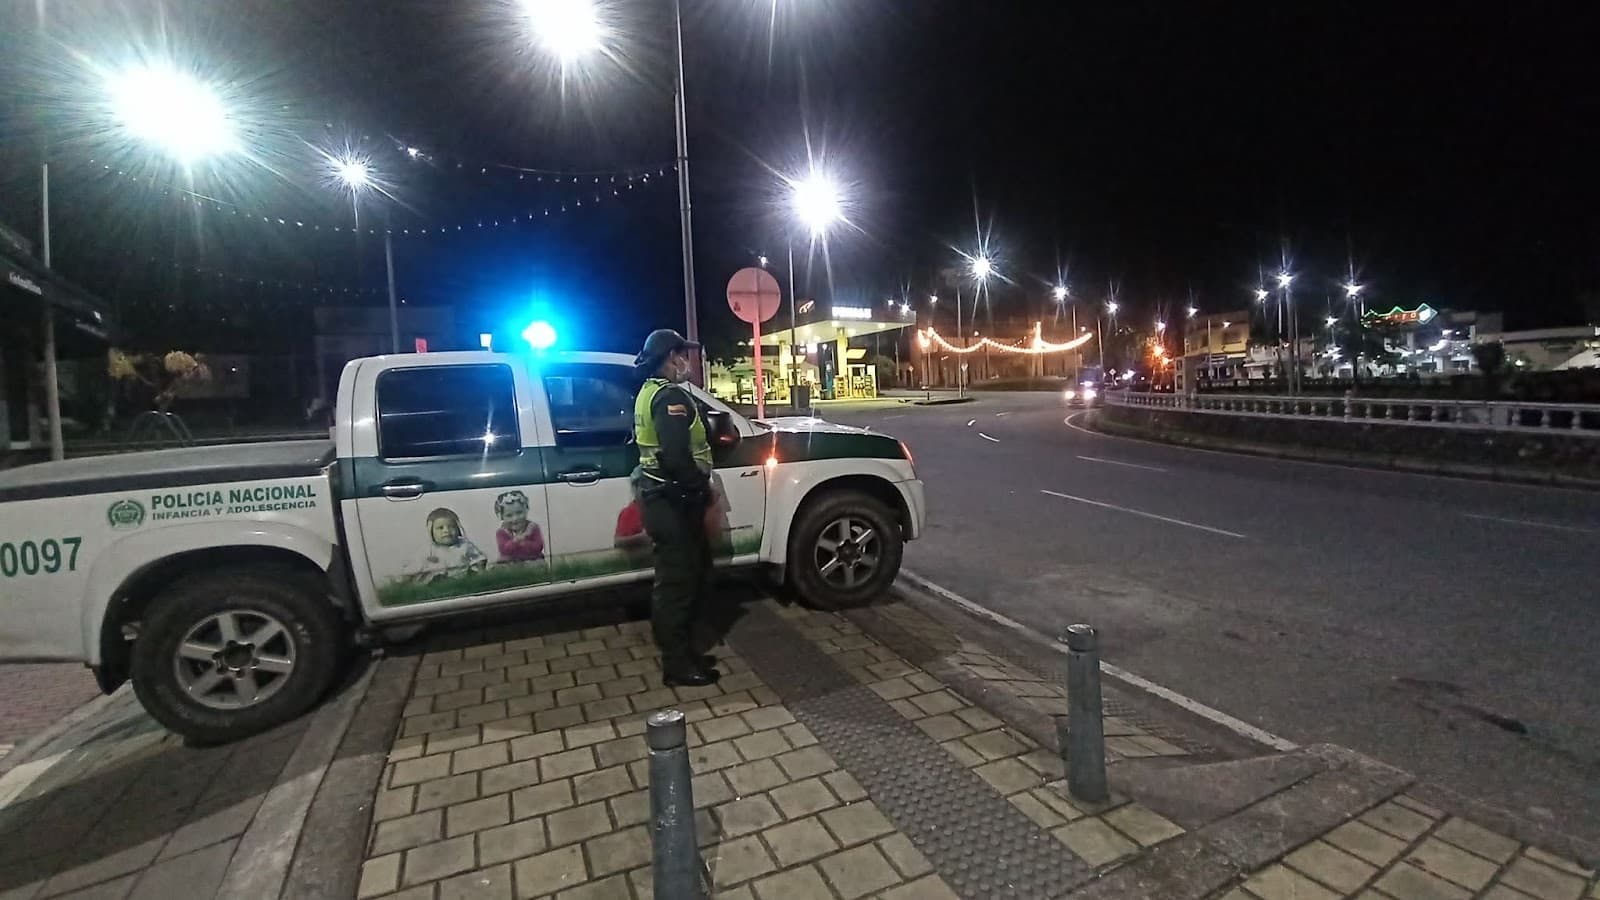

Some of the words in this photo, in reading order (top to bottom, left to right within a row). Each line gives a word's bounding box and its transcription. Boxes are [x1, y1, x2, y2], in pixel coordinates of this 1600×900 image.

[151, 491, 224, 510] POLICIA
[229, 484, 317, 503] NACIONAL
[152, 508, 211, 520] INFANCIA
[215, 507, 223, 516] Y
[226, 500, 317, 514] ADOLESCENCIA
[0, 536, 82, 577] 0097
